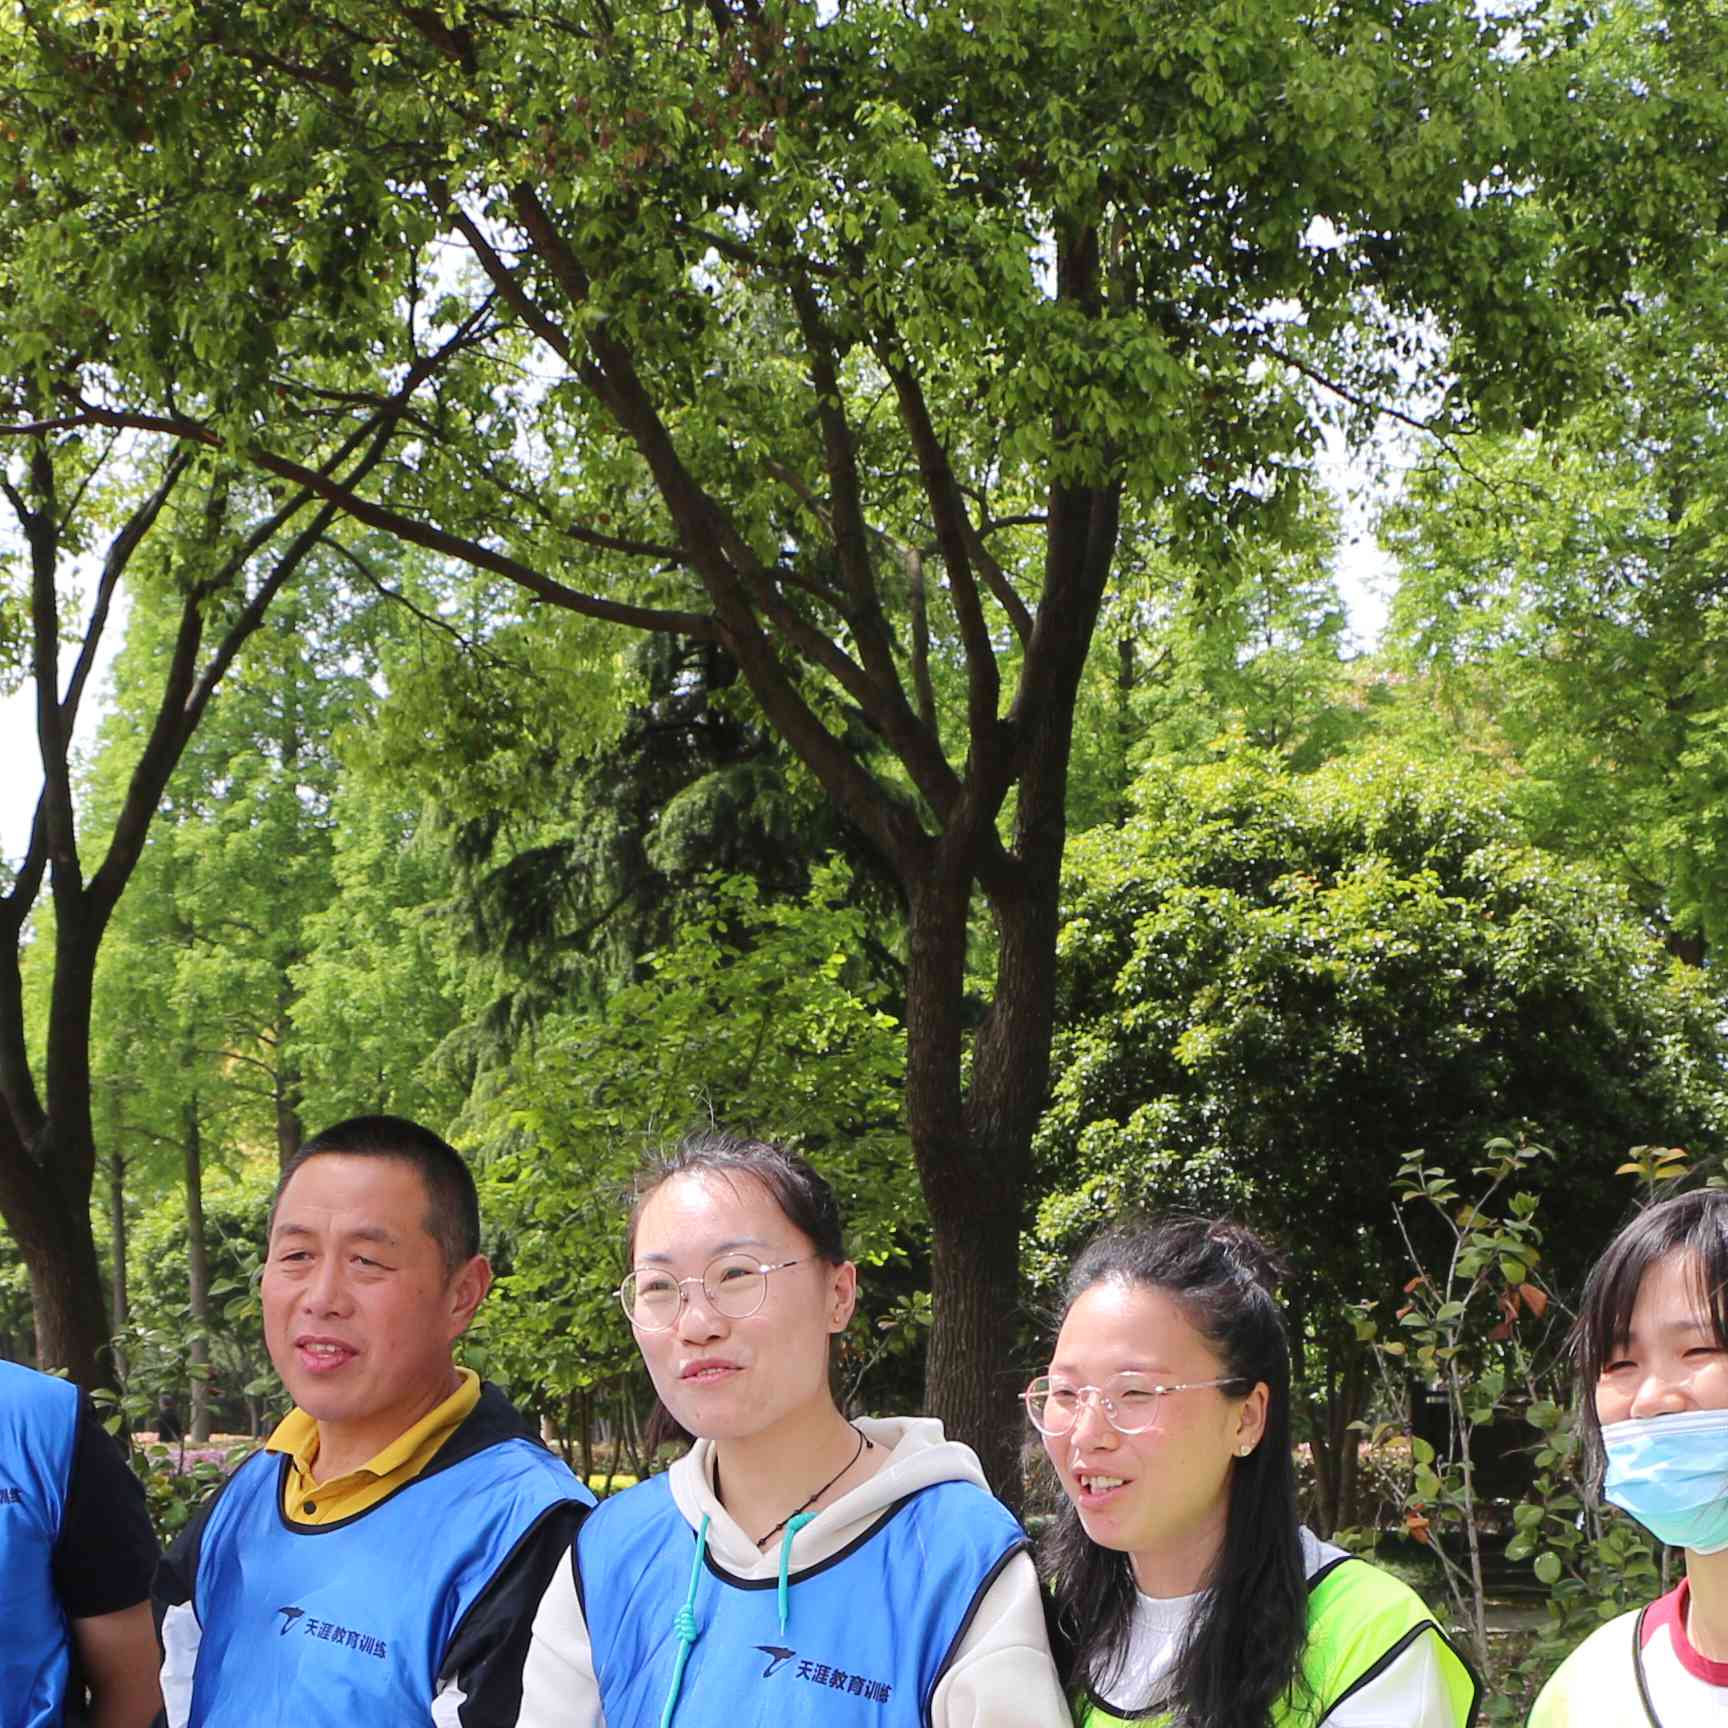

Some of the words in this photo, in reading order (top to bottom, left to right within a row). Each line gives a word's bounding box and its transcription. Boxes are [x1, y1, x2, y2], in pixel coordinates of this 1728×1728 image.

[304, 1618, 387, 1659] 天涯教育训练
